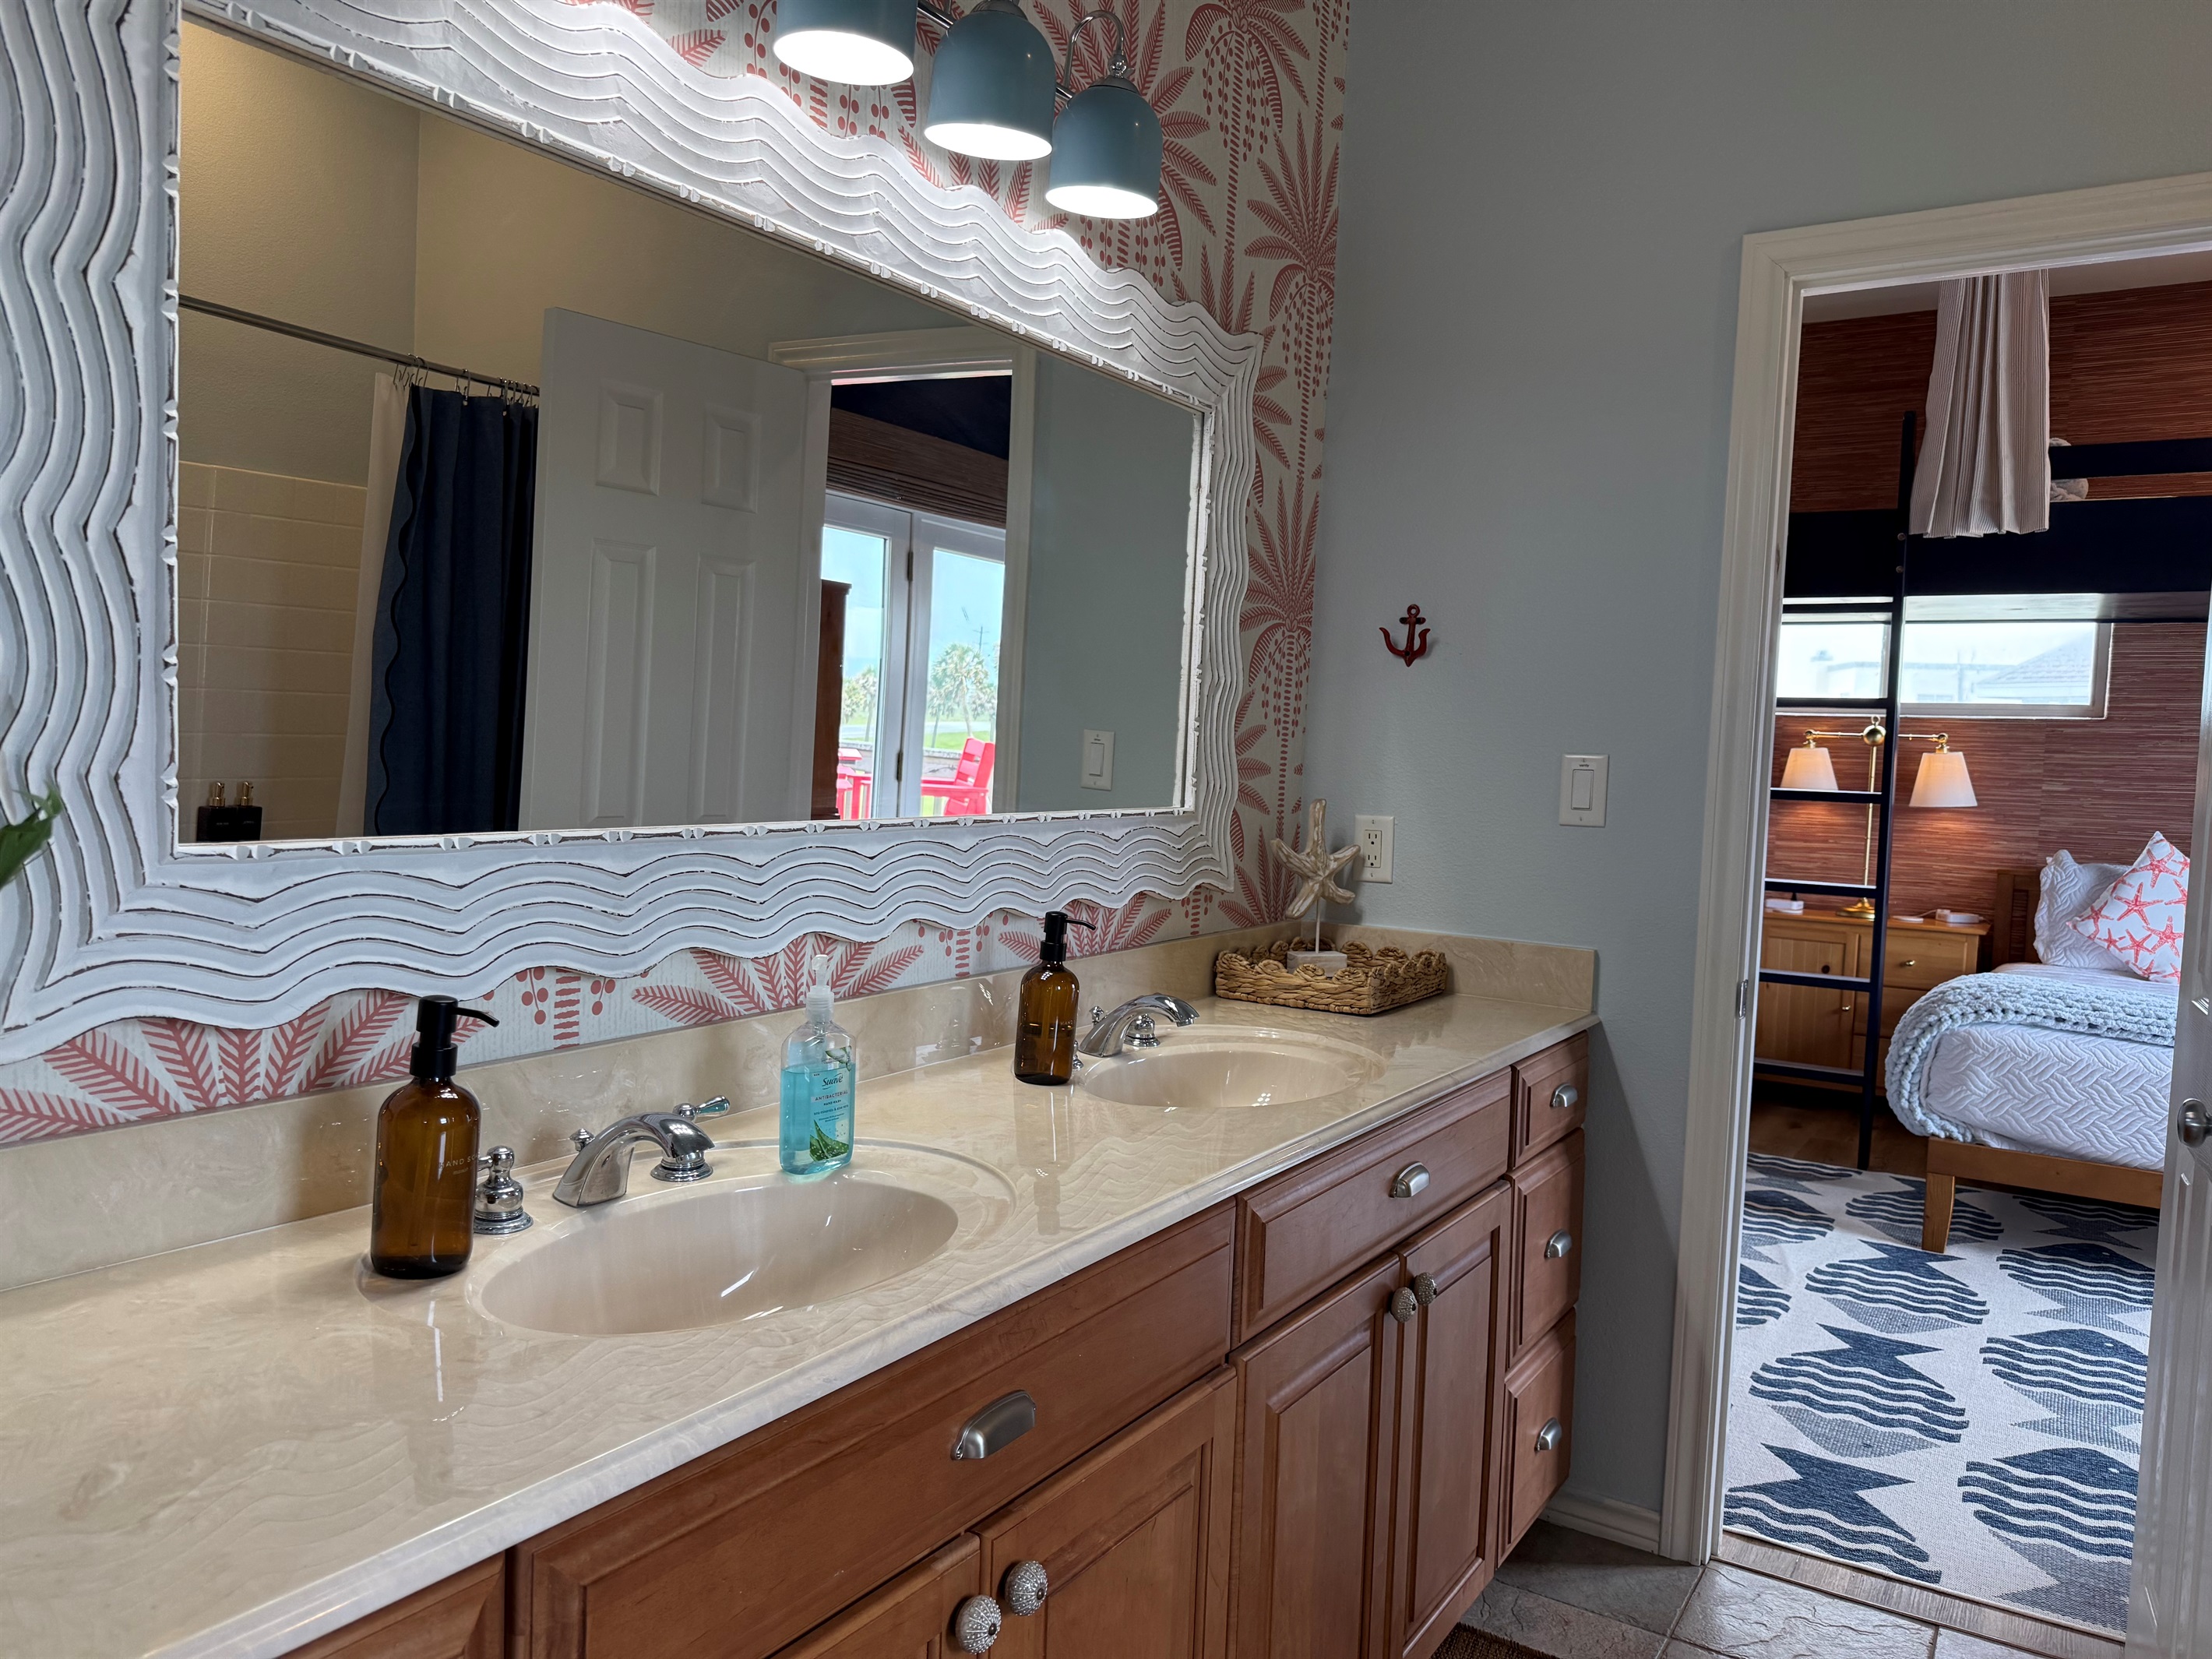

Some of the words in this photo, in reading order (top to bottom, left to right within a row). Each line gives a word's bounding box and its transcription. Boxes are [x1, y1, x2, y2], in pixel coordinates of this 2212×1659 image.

[822, 1073, 844, 1087] Suave
[815, 1090, 848, 1101] ANTIBACTERIAL
[439, 1158, 465, 1168] HAND
